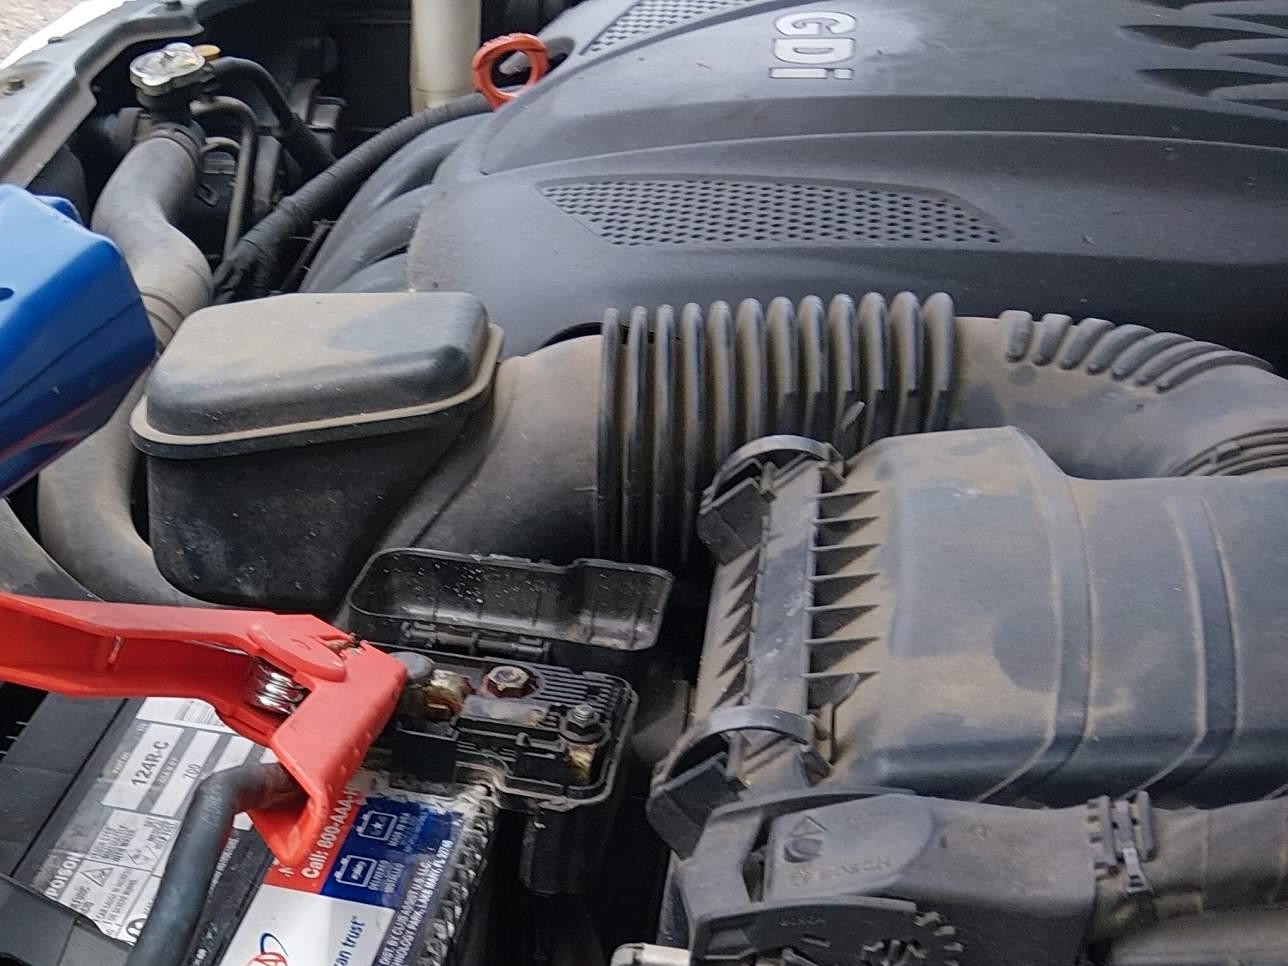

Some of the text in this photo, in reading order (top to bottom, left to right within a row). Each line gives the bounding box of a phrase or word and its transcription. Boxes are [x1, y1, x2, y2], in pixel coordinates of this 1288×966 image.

[770, 10, 856, 81] GDi
[132, 740, 170, 786] 124R-C
[302, 787, 358, 878] Call: 800-AAA-H
[341, 920, 365, 949] trust
